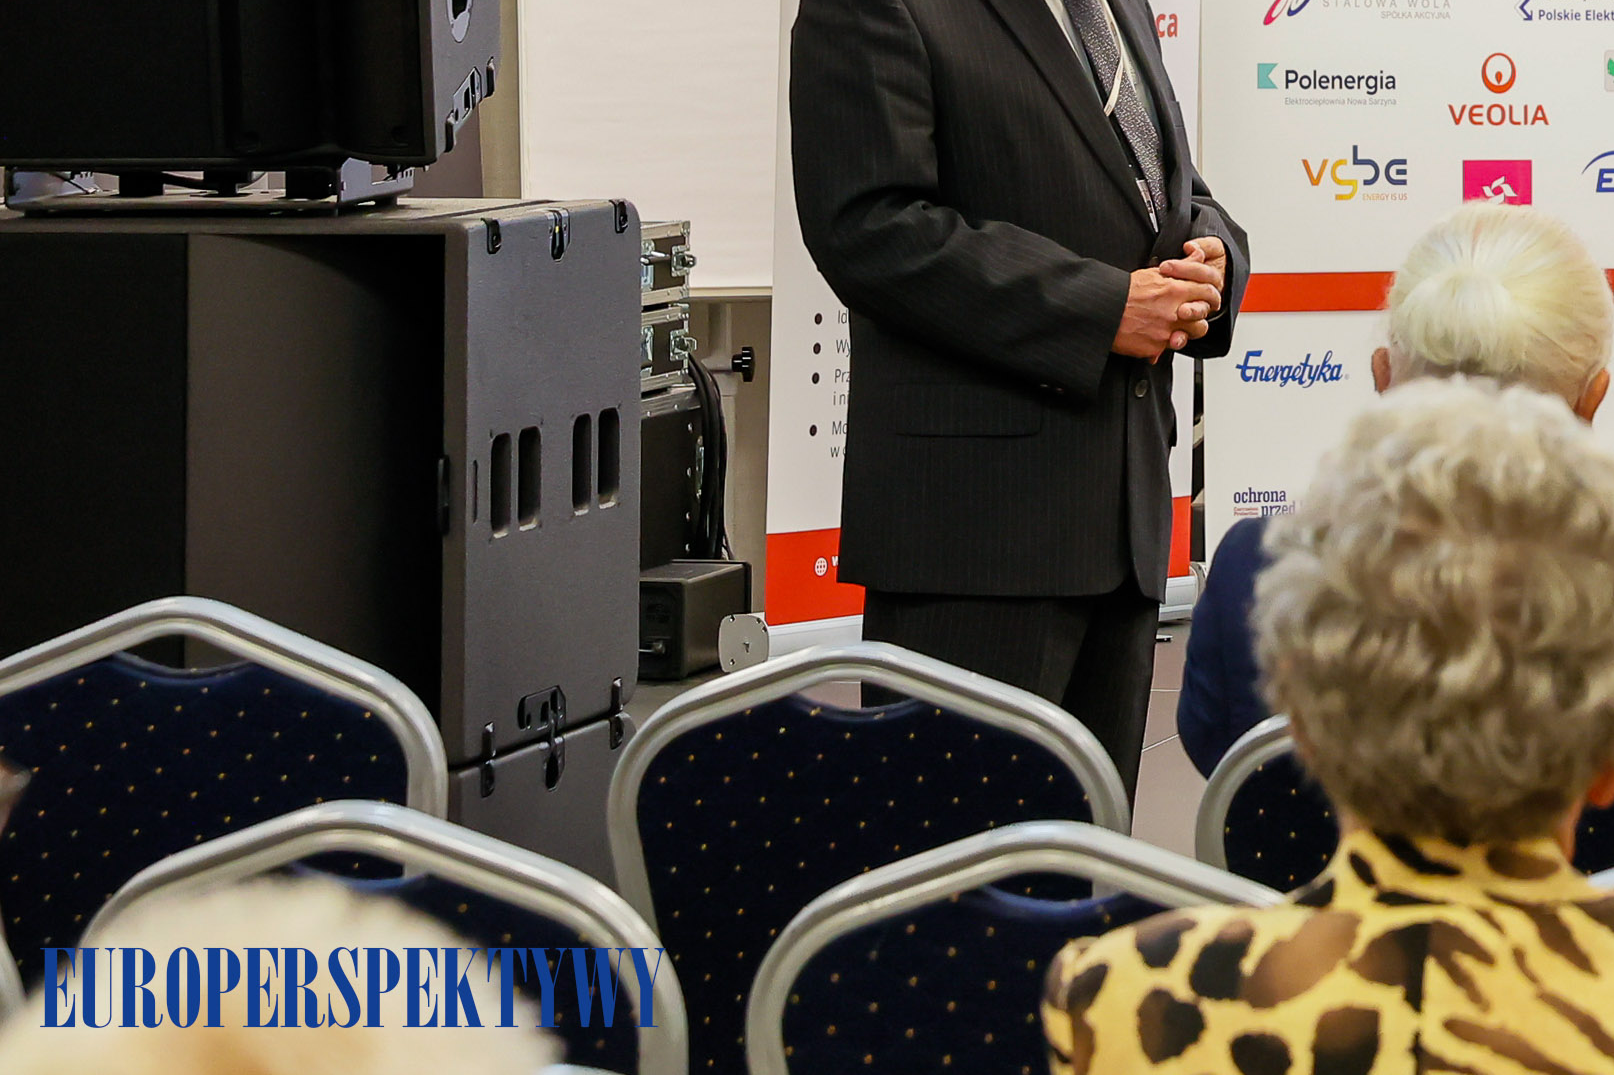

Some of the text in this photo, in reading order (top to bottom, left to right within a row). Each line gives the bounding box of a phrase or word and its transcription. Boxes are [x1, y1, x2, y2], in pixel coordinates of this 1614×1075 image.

[1538, 9, 1581, 21] Polskie
[1285, 69, 1397, 95] Polenergia
[1368, 98, 1397, 107] Sarzyna
[1448, 104, 1549, 126] VEOLIA
[1362, 193, 1390, 201] ENERGY
[1235, 349, 1343, 388] Energetyka
[1233, 487, 1287, 504] ochrona
